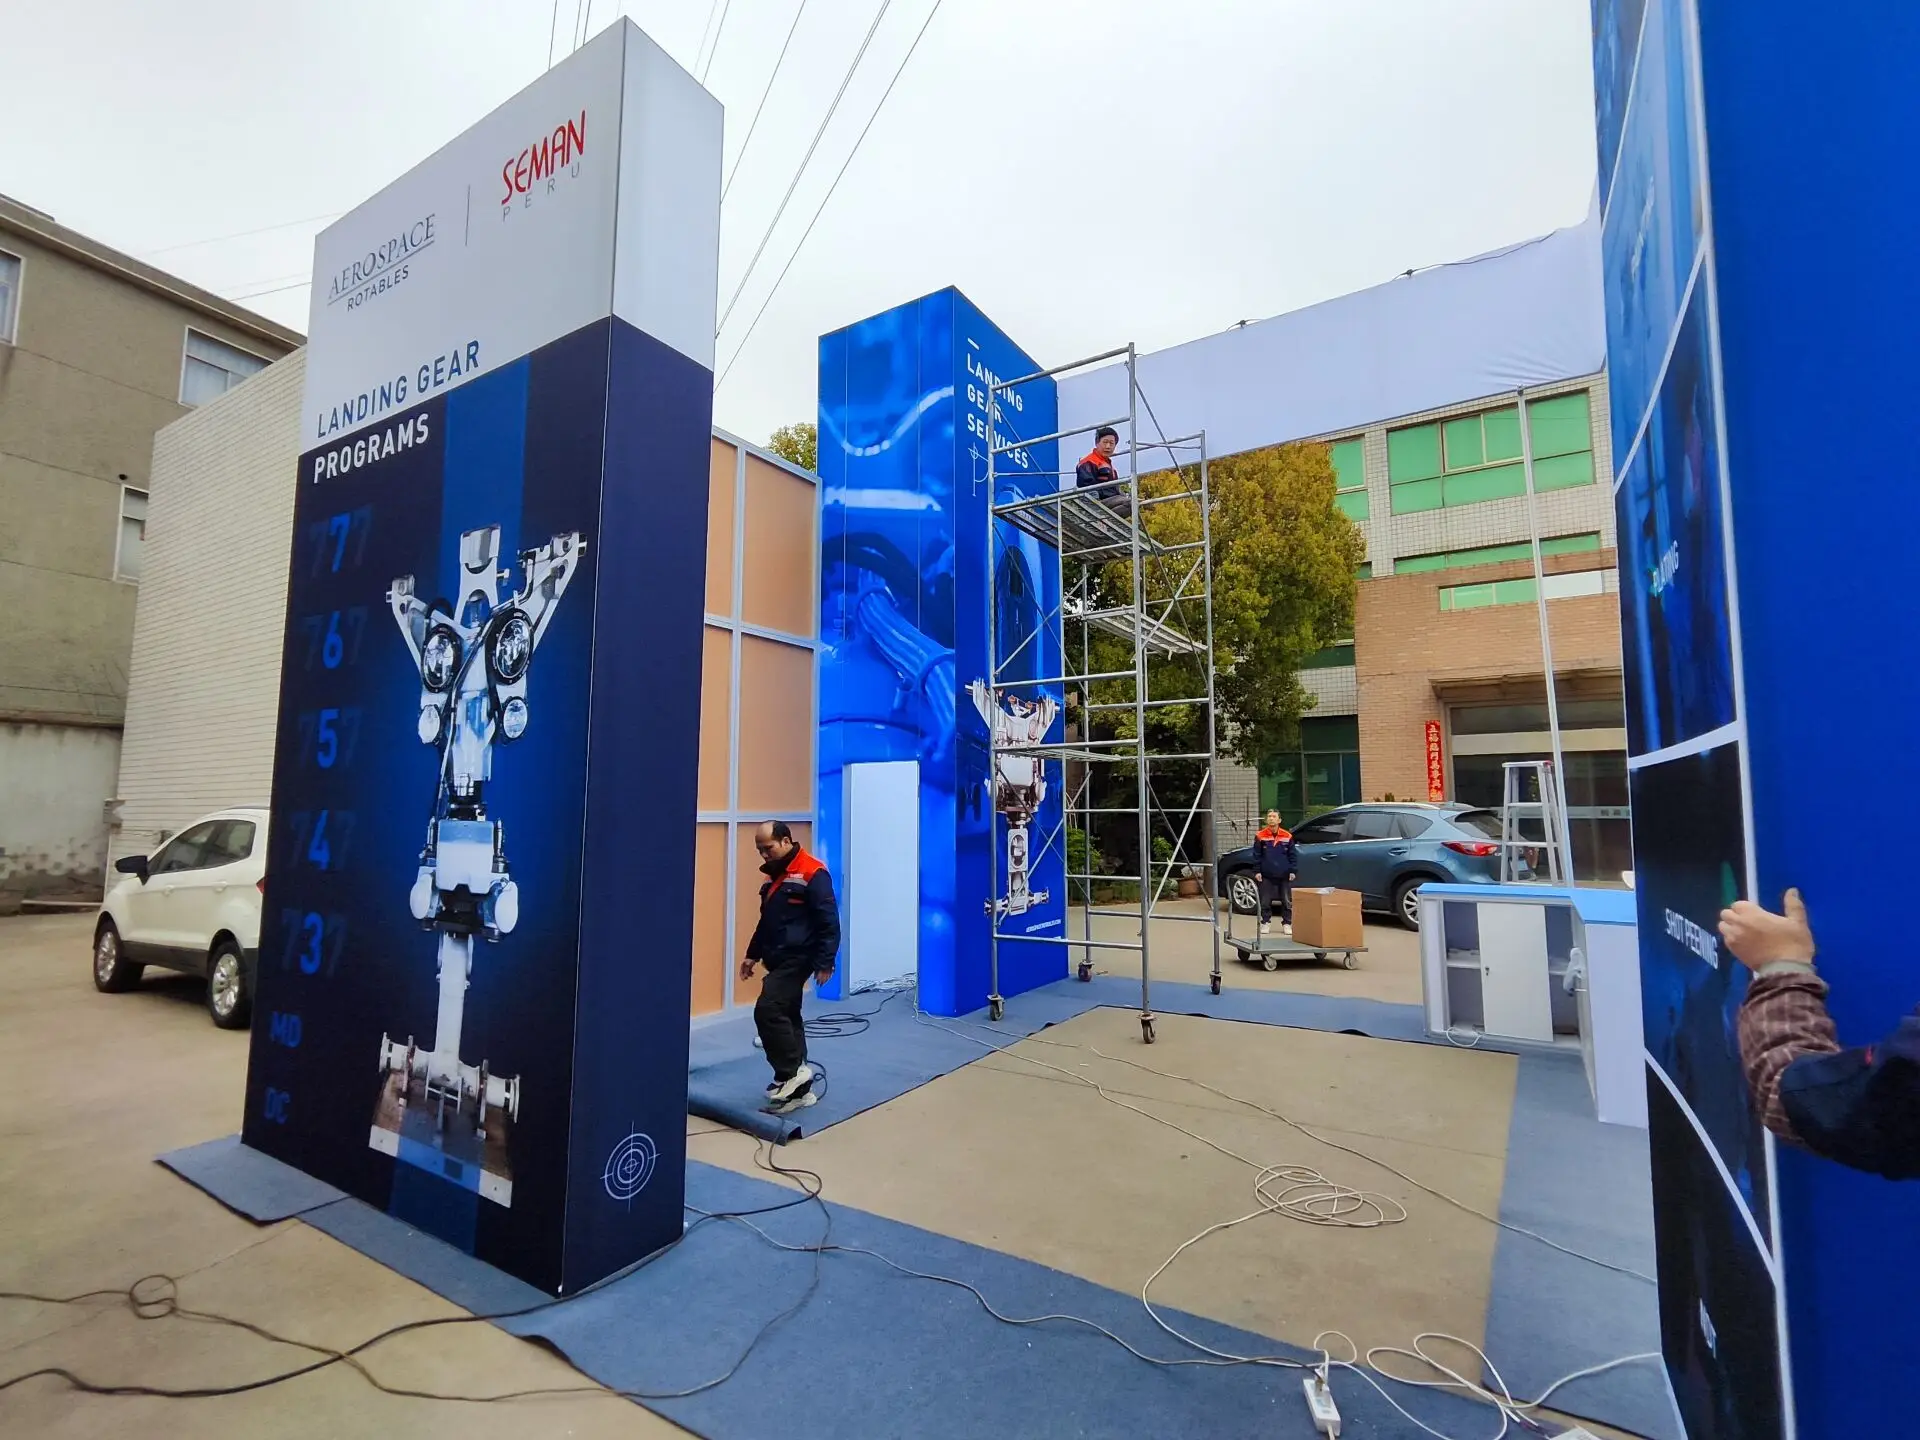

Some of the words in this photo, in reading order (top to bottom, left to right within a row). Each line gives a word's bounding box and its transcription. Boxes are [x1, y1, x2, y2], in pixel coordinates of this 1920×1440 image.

[502, 109, 586, 205] SEMAN
[502, 161, 580, 222] PERU
[328, 213, 436, 300] AEROSPACE
[347, 264, 409, 312] ROTABLES
[317, 375, 408, 438] LANDING
[417, 339, 479, 393] GEAR
[313, 412, 429, 484] PROGRAMS
[270, 1011, 302, 1048] MD
